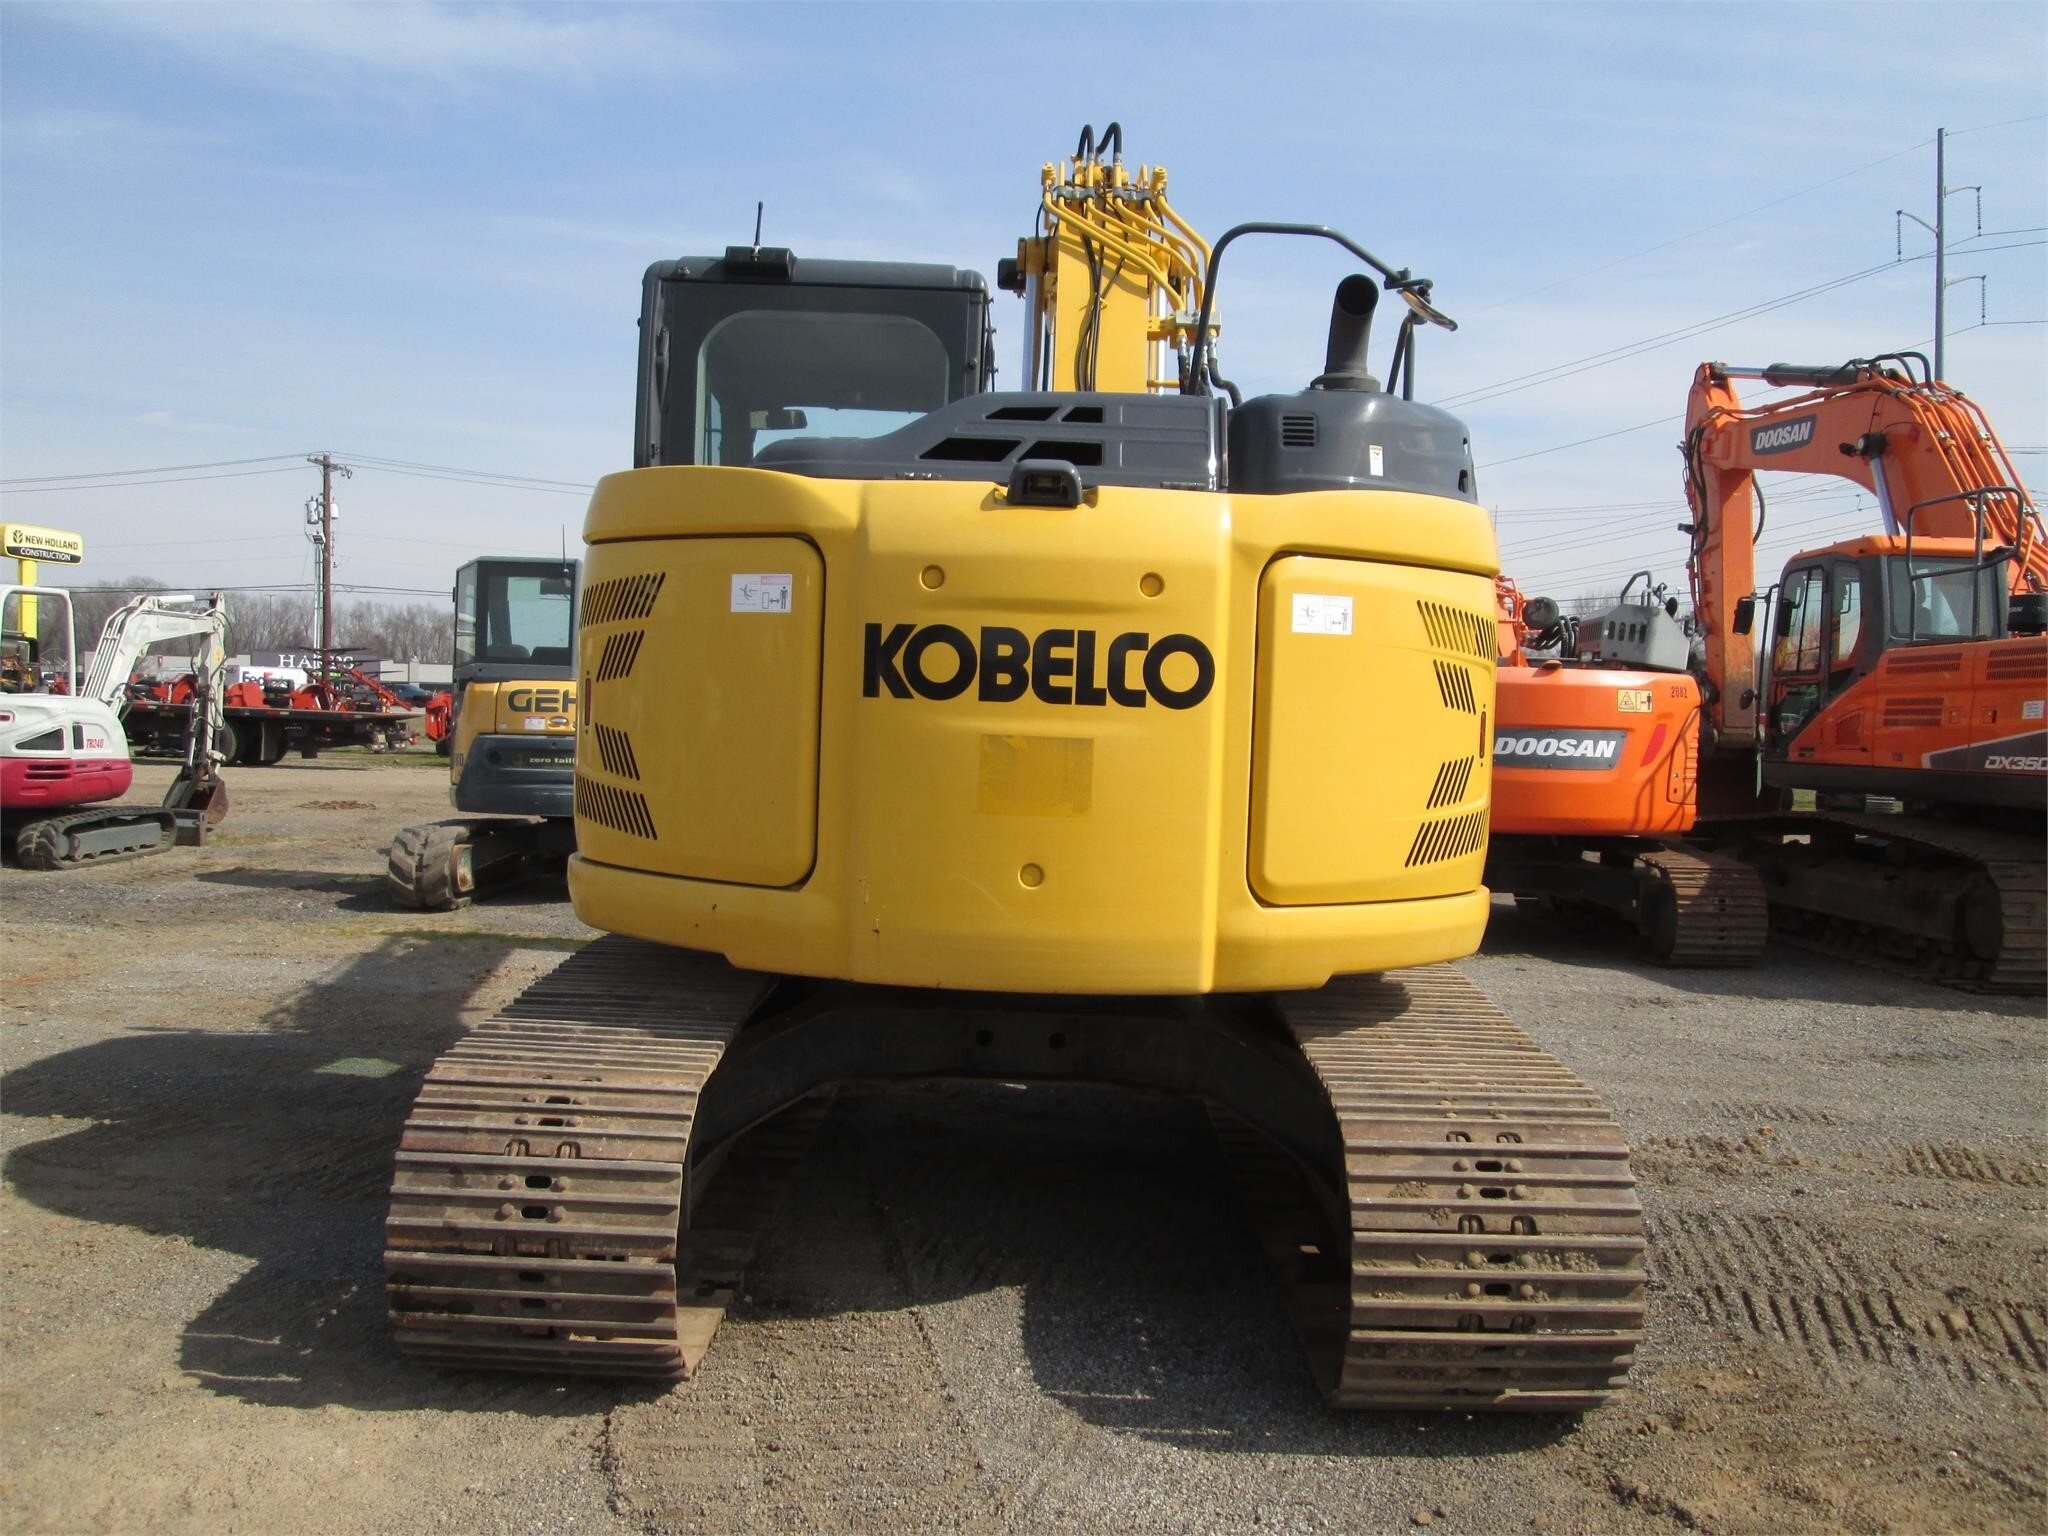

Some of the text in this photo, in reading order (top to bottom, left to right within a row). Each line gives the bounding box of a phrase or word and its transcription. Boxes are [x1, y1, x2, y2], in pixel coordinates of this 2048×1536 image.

[1755, 421, 1811, 450] DOOSAN
[25, 534, 79, 551] NEW HOLLAND
[20, 547, 71, 561] CONSTRUCTION
[863, 623, 1215, 710] KOBELCO
[1493, 737, 1616, 758] DOOSAN
